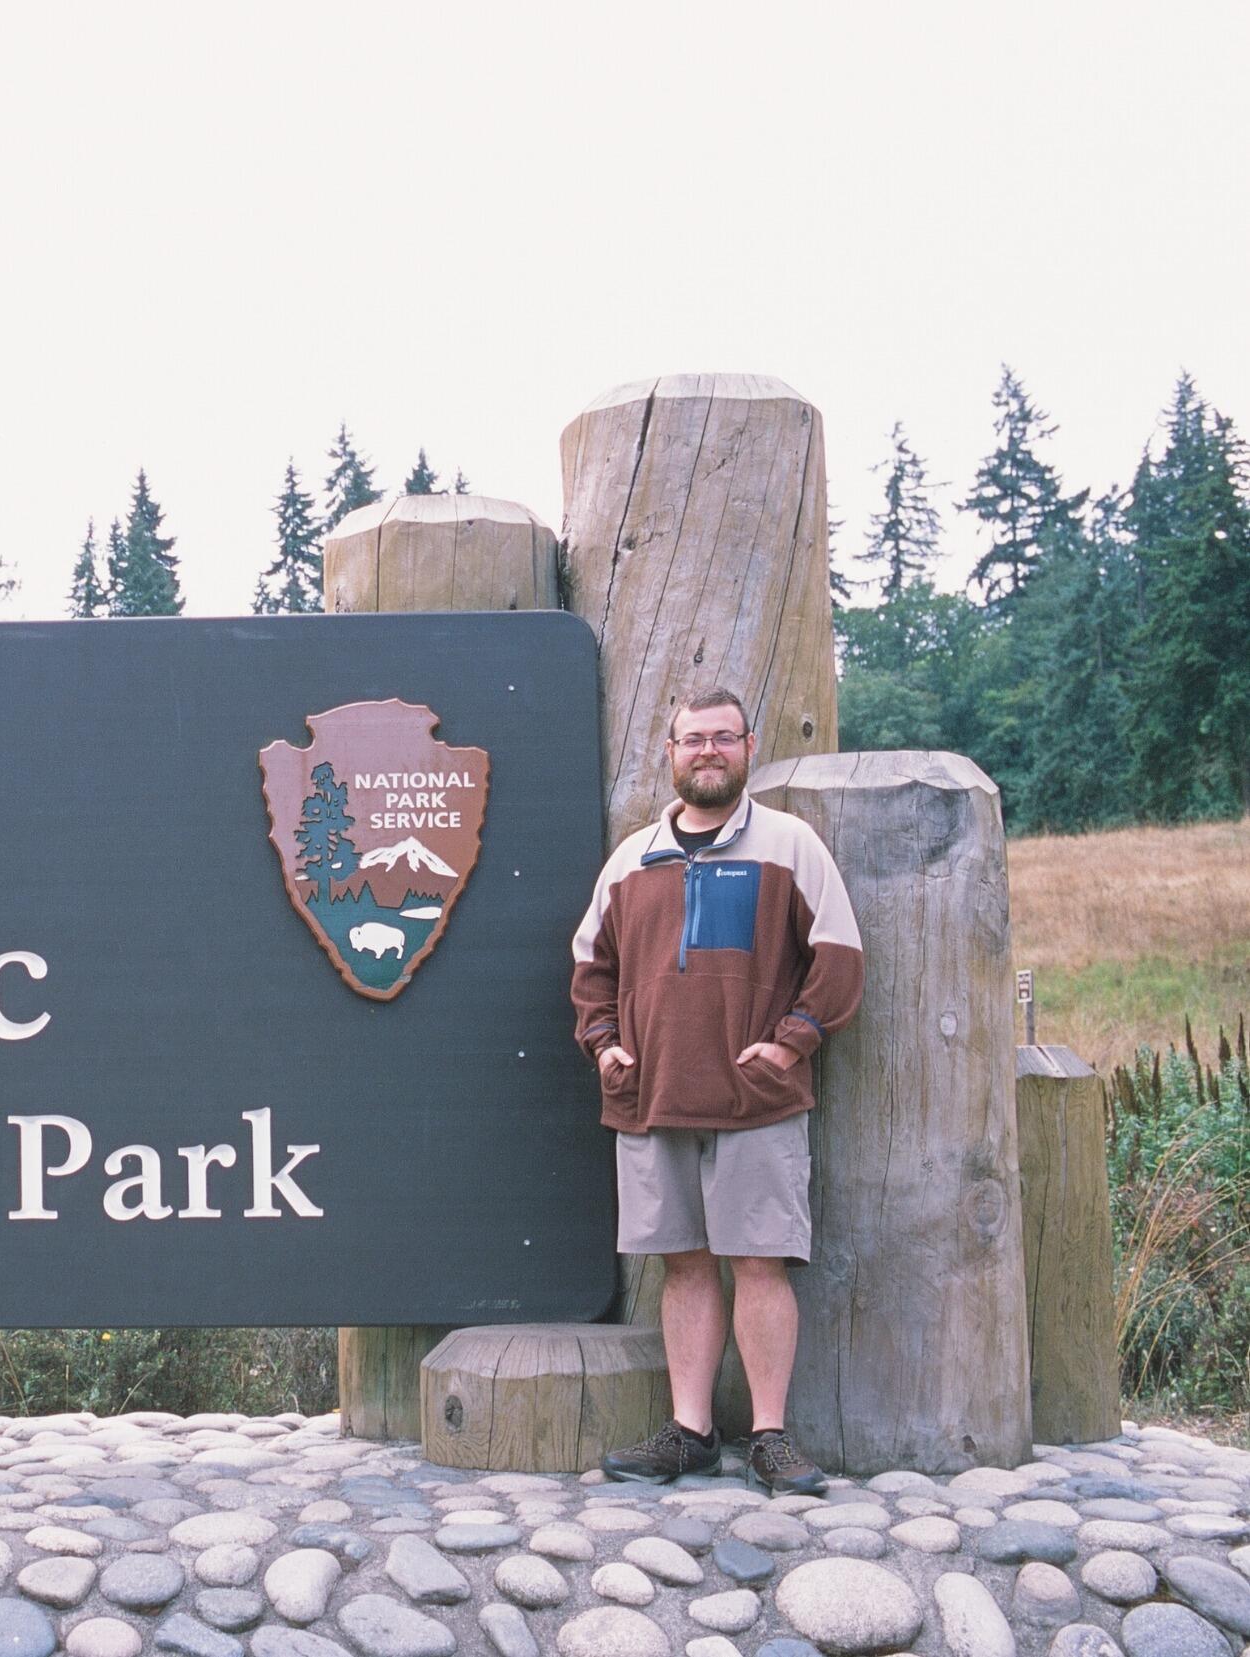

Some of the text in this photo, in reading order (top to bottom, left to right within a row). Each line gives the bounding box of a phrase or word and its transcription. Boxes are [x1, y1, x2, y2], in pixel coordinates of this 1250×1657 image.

[354, 771, 476, 789] NATIONAL
[385, 791, 447, 809] PARK
[370, 811, 461, 829] SERVICE
[7, 1107, 325, 1222] Park
